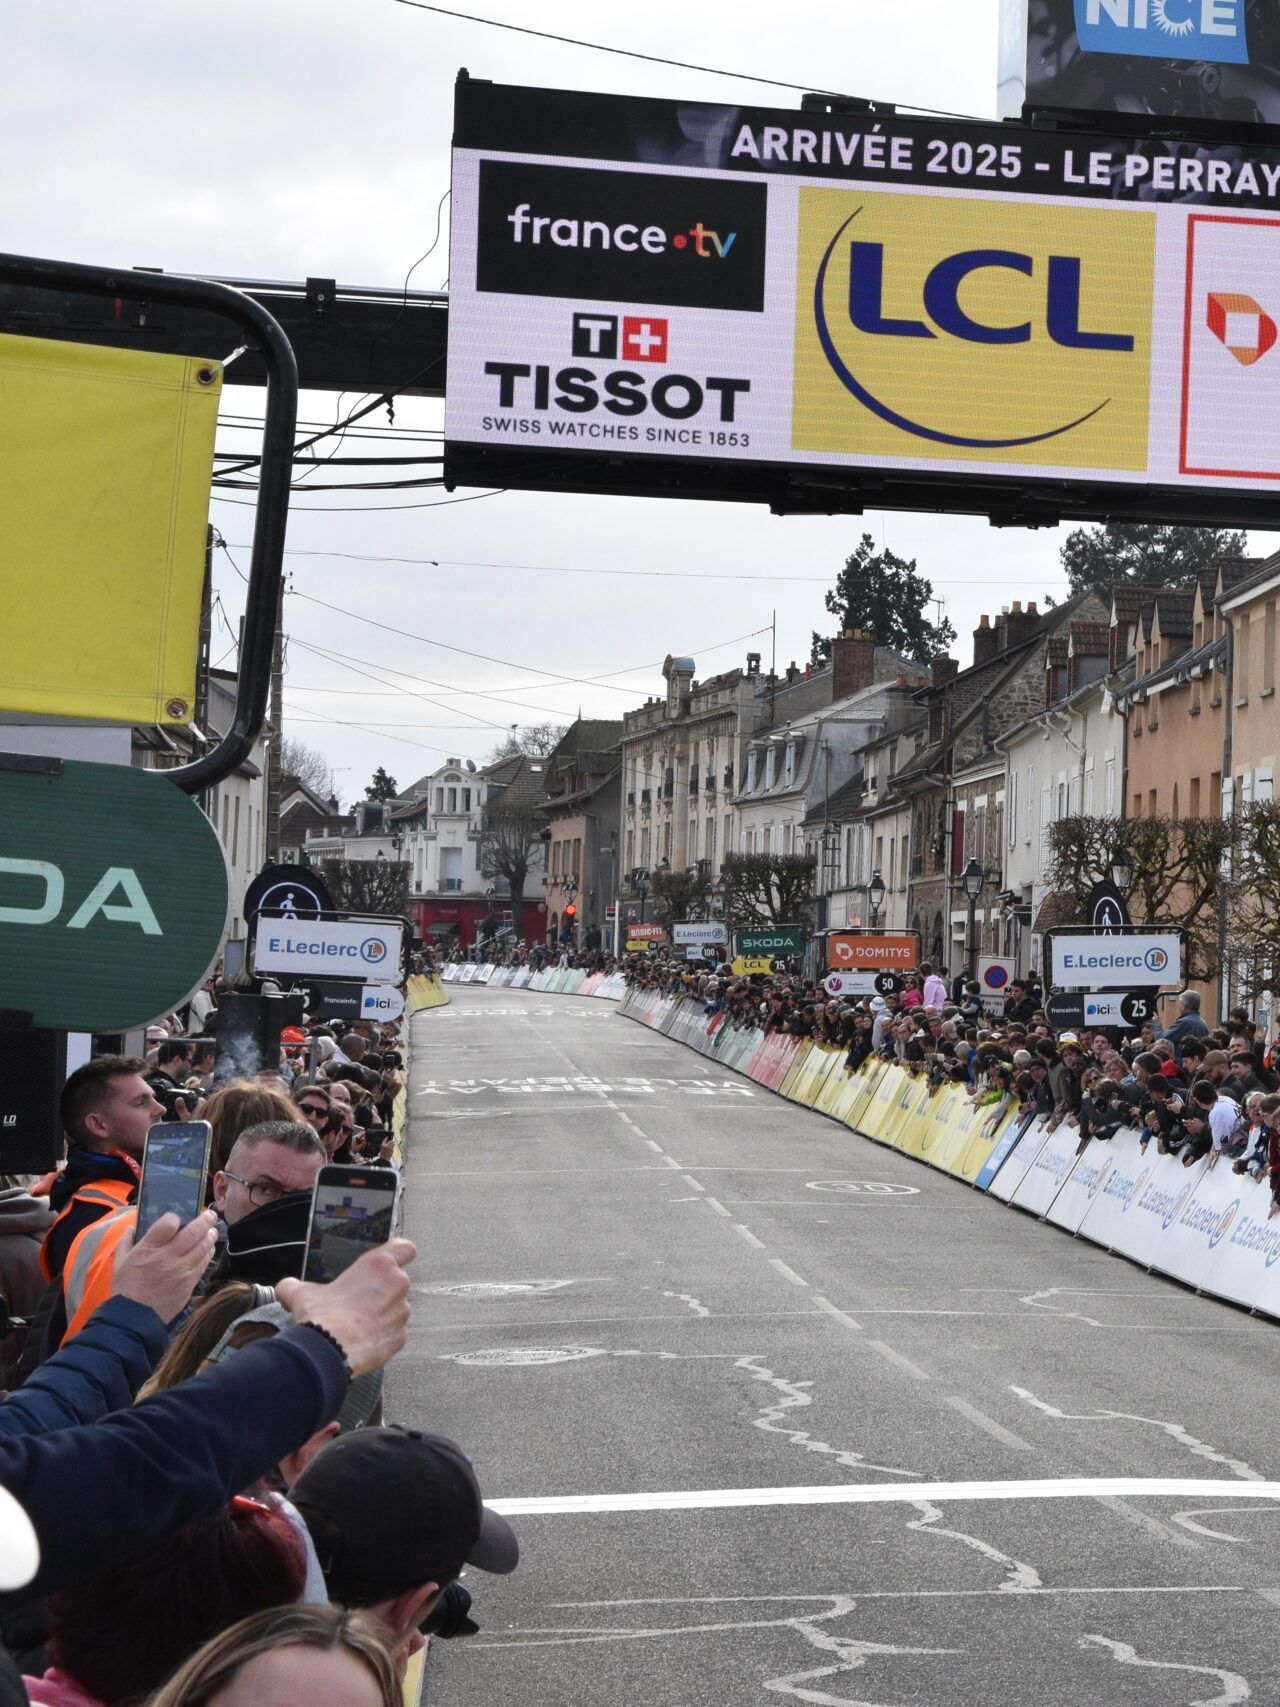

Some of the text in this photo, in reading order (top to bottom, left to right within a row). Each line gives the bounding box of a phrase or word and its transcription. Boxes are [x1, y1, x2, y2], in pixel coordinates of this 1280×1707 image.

[731, 125, 914, 172] ARRIVÉE
[925, 138, 1023, 177] 2025
[1064, 151, 1112, 186] LE
[848, 240, 1134, 352] LCL
[484, 361, 751, 422] TISSOT
[482, 416, 750, 447] SWISS WATCHES SINCE 1853
[269, 938, 358, 957] E.Leclerc
[704, 948, 715, 956] 100
[856, 946, 911, 959] DOMITYS
[744, 960, 765, 969] LCL
[1063, 954, 1143, 969] E.Leclerc
[882, 977, 894, 990] 50
[376, 997, 391, 1009] ici
[1097, 1004, 1110, 1015] ici
[1131, 999, 1147, 1017] 25
[1179, 1198, 1221, 1236] E.Leclerc
[1231, 1216, 1280, 1257] E.Leclerc
